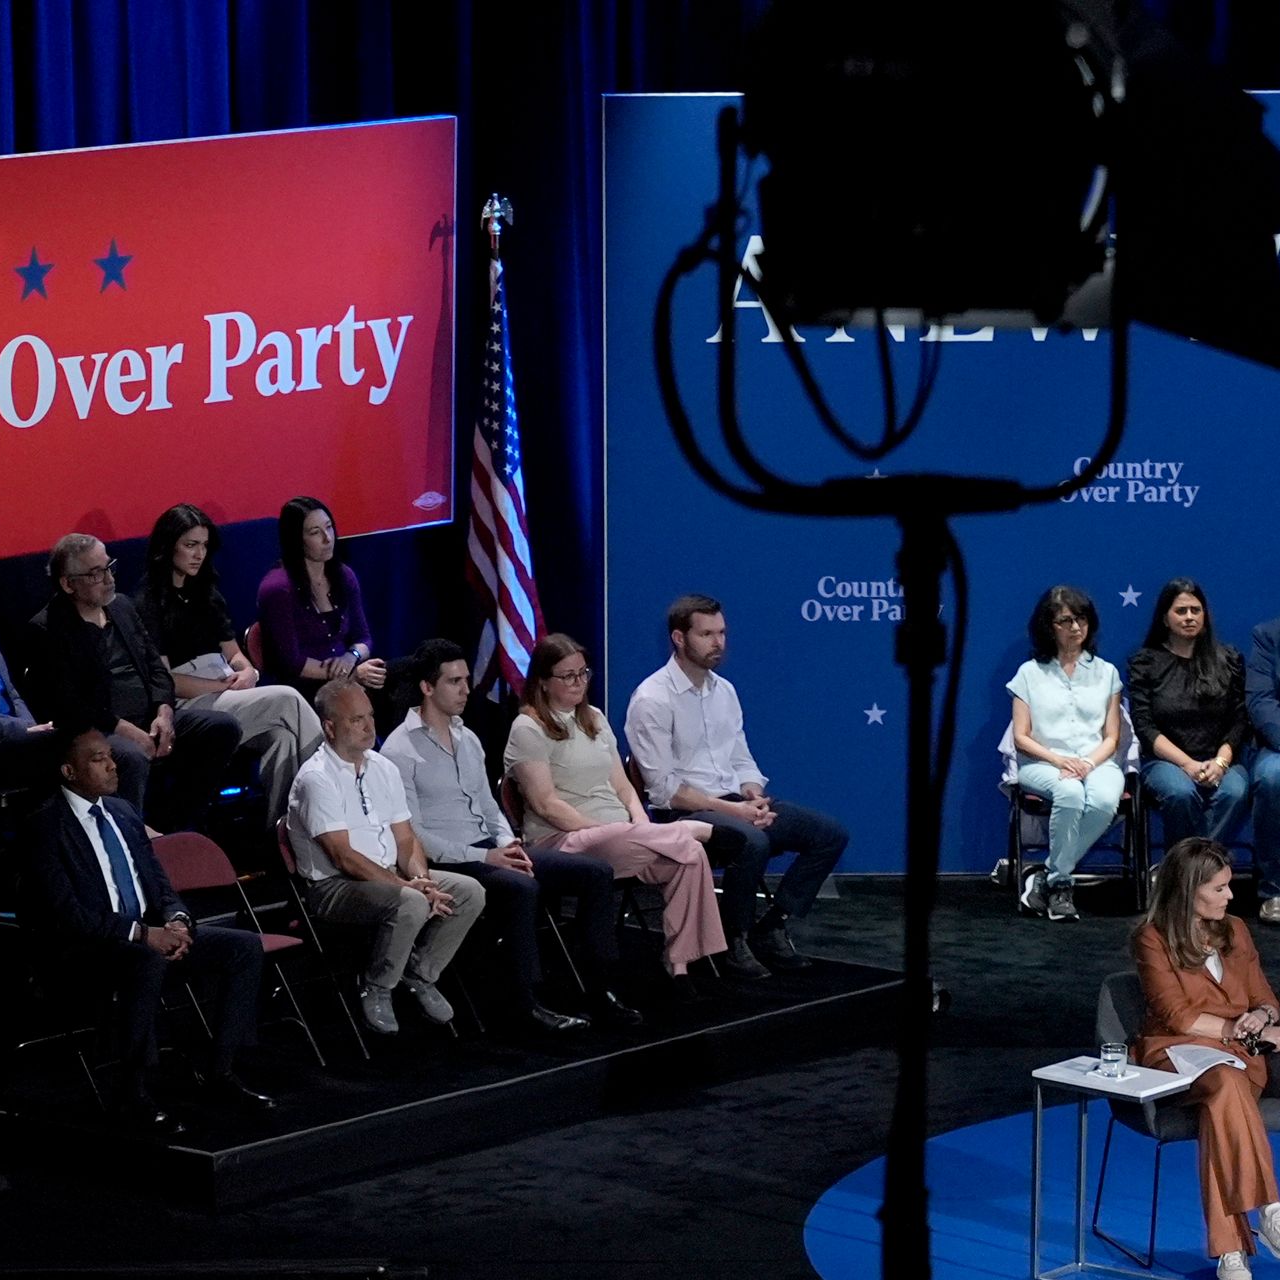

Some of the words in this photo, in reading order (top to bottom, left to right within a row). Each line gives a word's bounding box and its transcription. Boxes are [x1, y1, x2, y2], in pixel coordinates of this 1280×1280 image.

[204, 304, 415, 406] Party
[1126, 480, 1201, 508] Party
[817, 575, 906, 599] Count
[800, 599, 865, 622] Over
